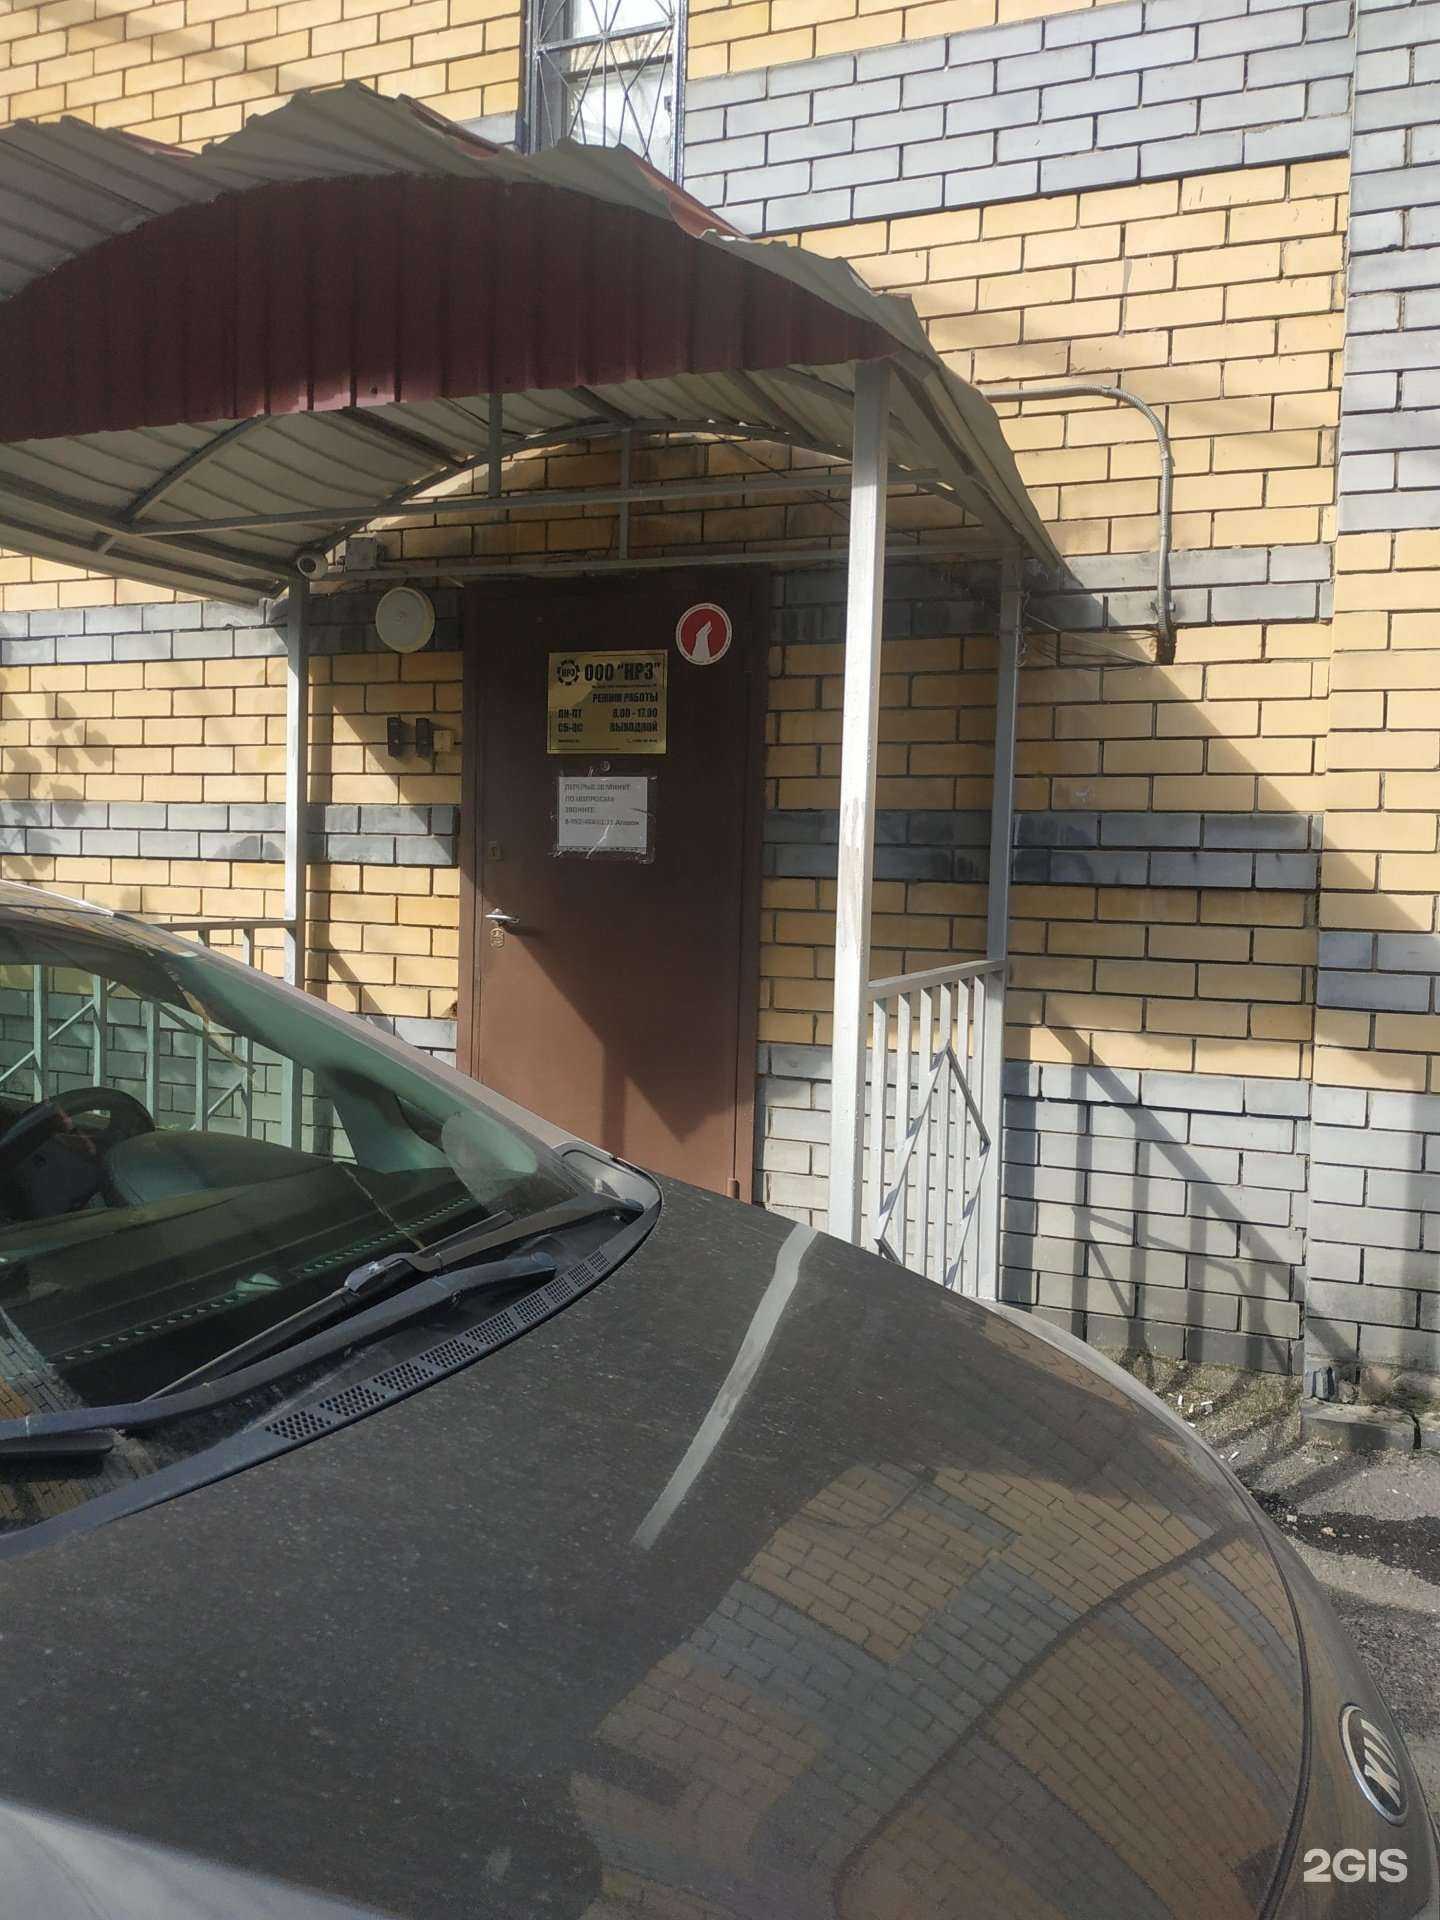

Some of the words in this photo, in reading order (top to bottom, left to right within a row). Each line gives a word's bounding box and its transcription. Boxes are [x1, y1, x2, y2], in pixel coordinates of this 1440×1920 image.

[584, 663, 614, 681] ООО
[623, 691, 658, 703] РАБОТЫ
[558, 708, 582, 719] ПН-ПТ
[609, 720, 658, 733] ВЫХОДНОЙ
